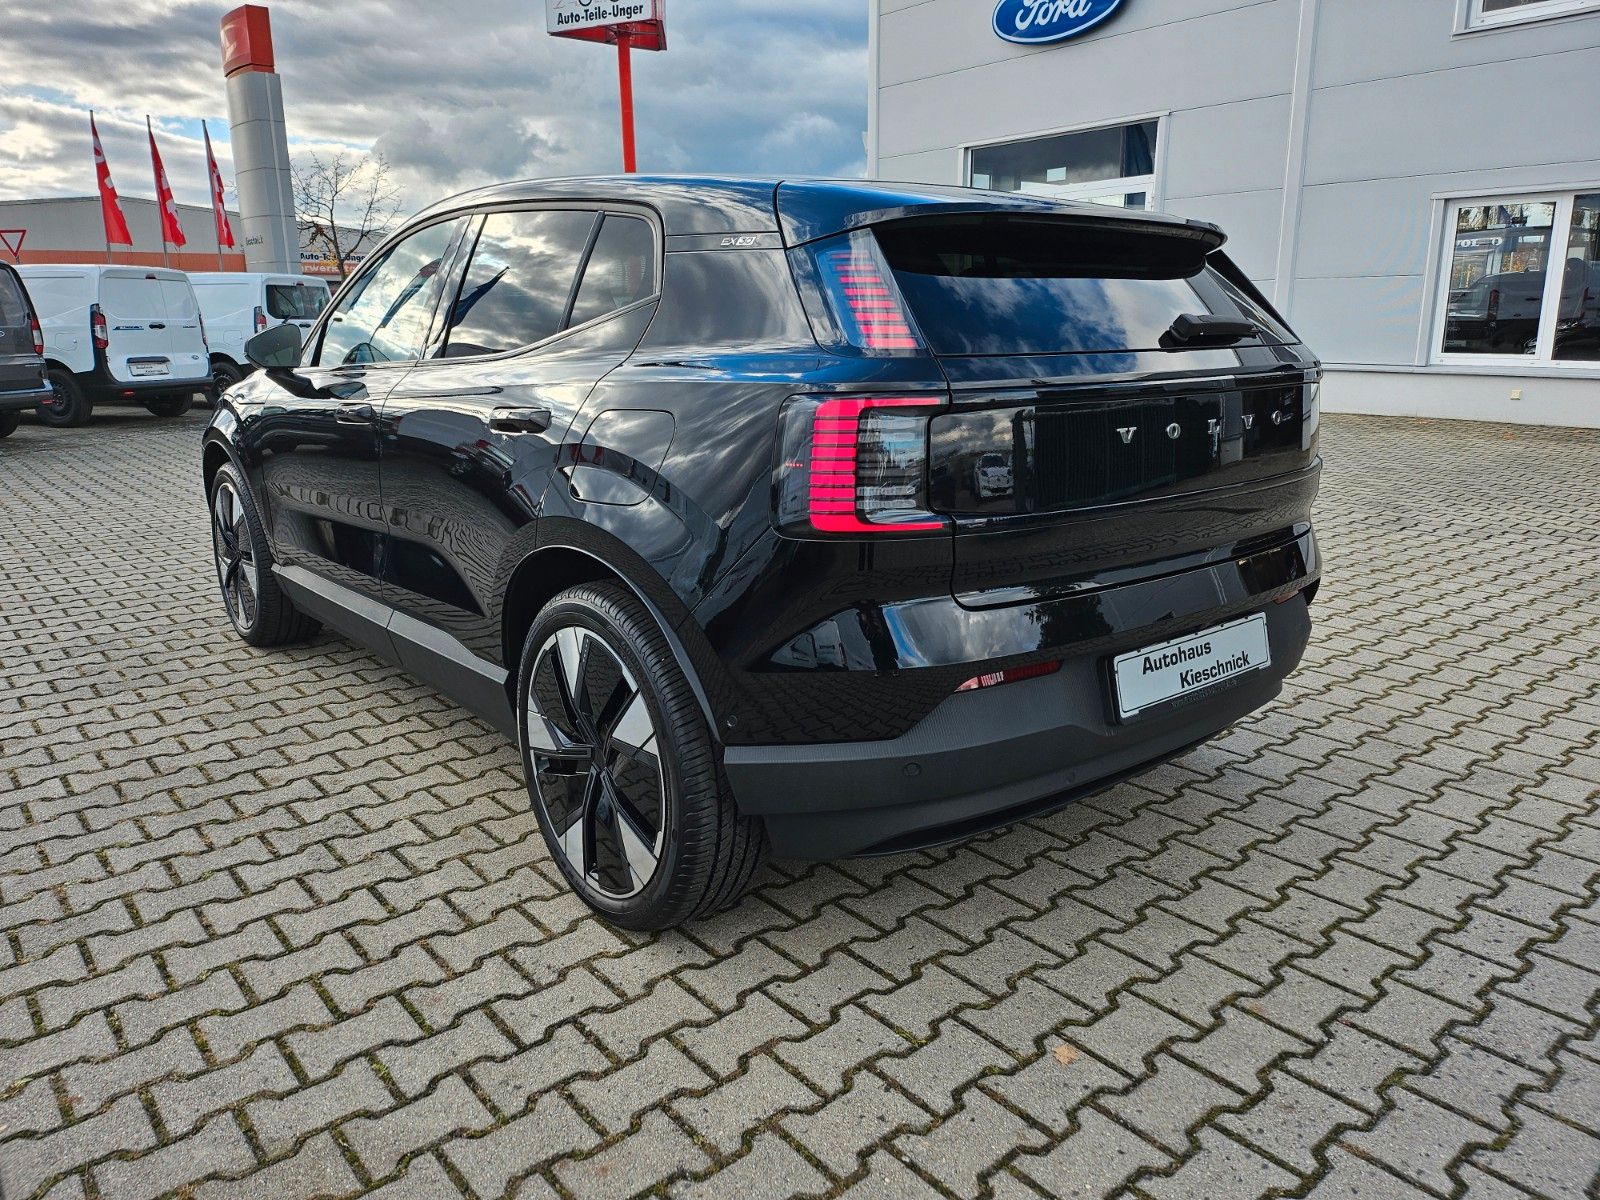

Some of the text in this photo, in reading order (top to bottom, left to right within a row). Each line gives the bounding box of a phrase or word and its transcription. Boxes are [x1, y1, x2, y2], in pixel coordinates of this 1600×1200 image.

[557, 5, 644, 26] Auto-Teile-Unger
[1116, 409, 1283, 444] VOLVO
[1142, 641, 1212, 675] Autohaus
[1179, 651, 1251, 689] Kieschnick
